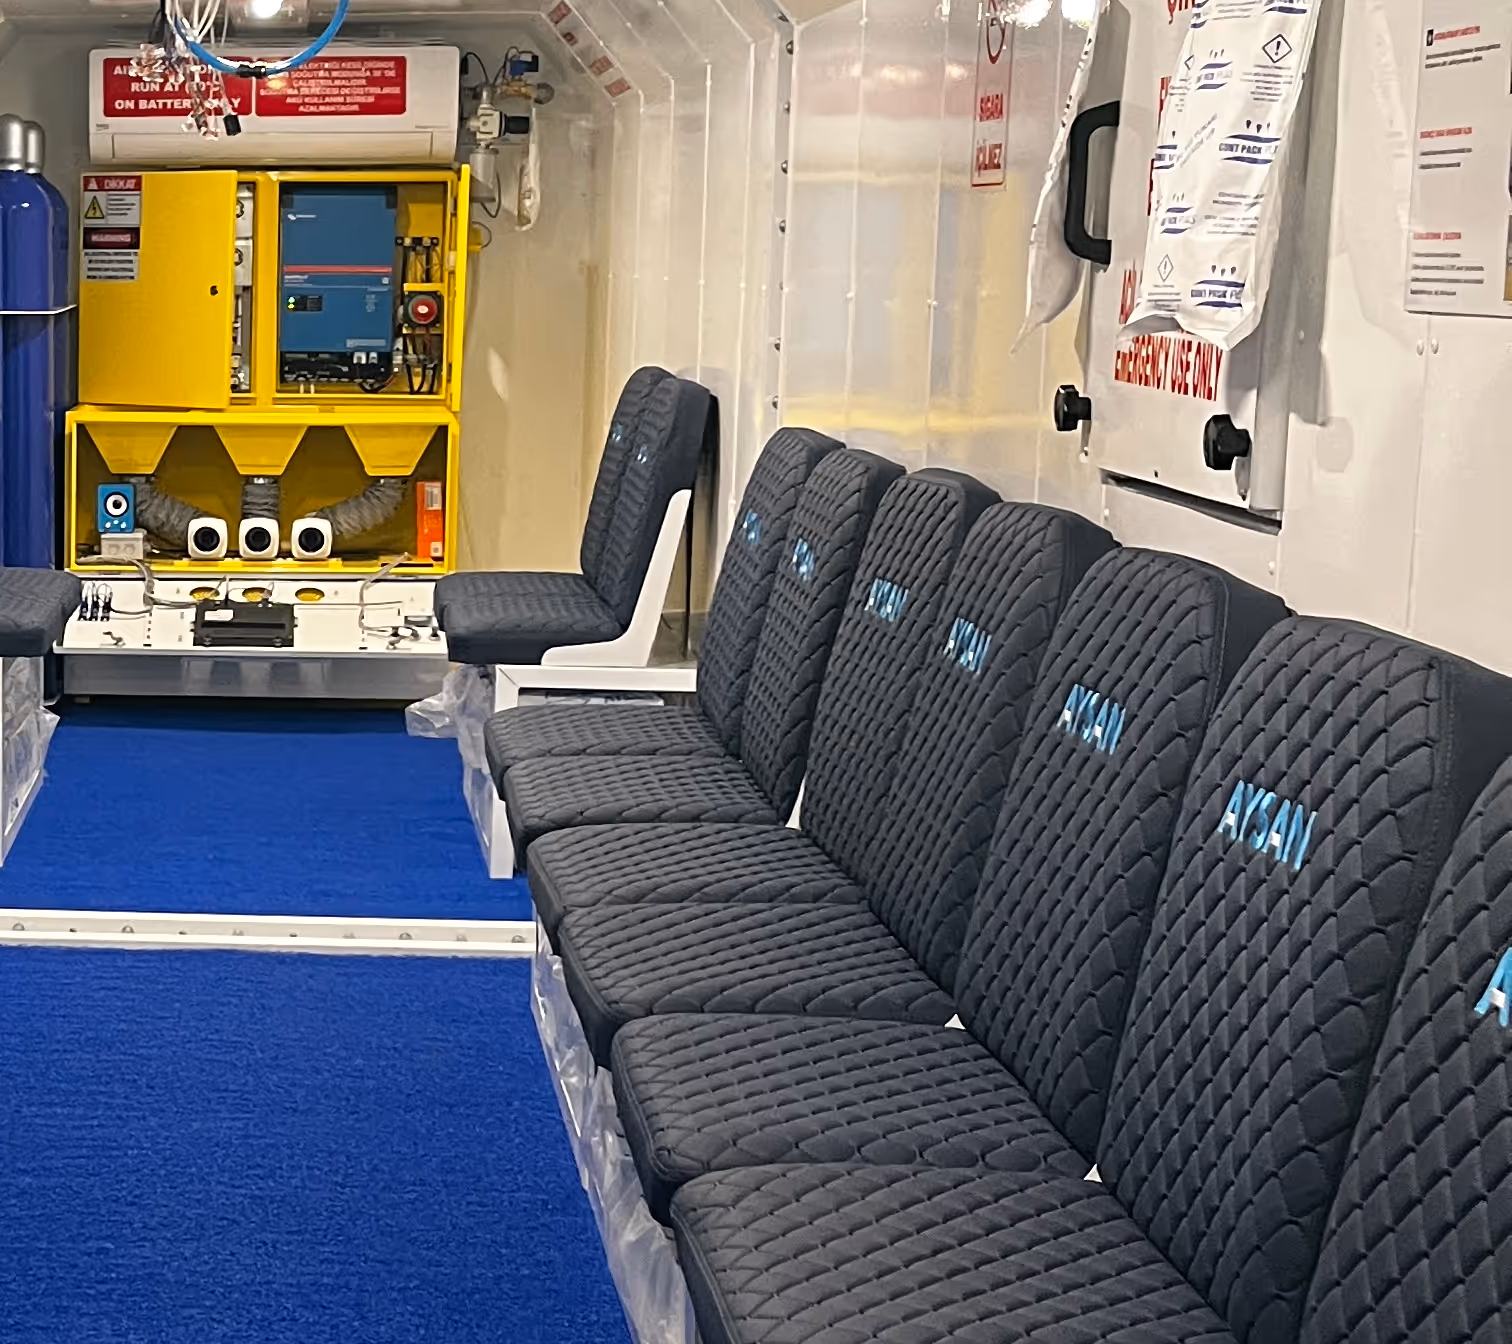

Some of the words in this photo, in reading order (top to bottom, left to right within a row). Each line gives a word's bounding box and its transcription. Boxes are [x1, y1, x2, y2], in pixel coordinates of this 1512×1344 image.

[114, 99, 135, 110] ON
[131, 82, 160, 93] RUN
[164, 81, 180, 92] AT
[1219, 143, 1240, 153] CONT
[1241, 145, 1262, 154] PACK
[1114, 334, 1171, 391] EMERGENCY
[1171, 338, 1193, 397] USE
[1192, 340, 1224, 402] ONLY
[943, 617, 993, 679] AYSAN
[1056, 683, 1127, 756] AYSAN
[1216, 779, 1318, 871] AYSAN
